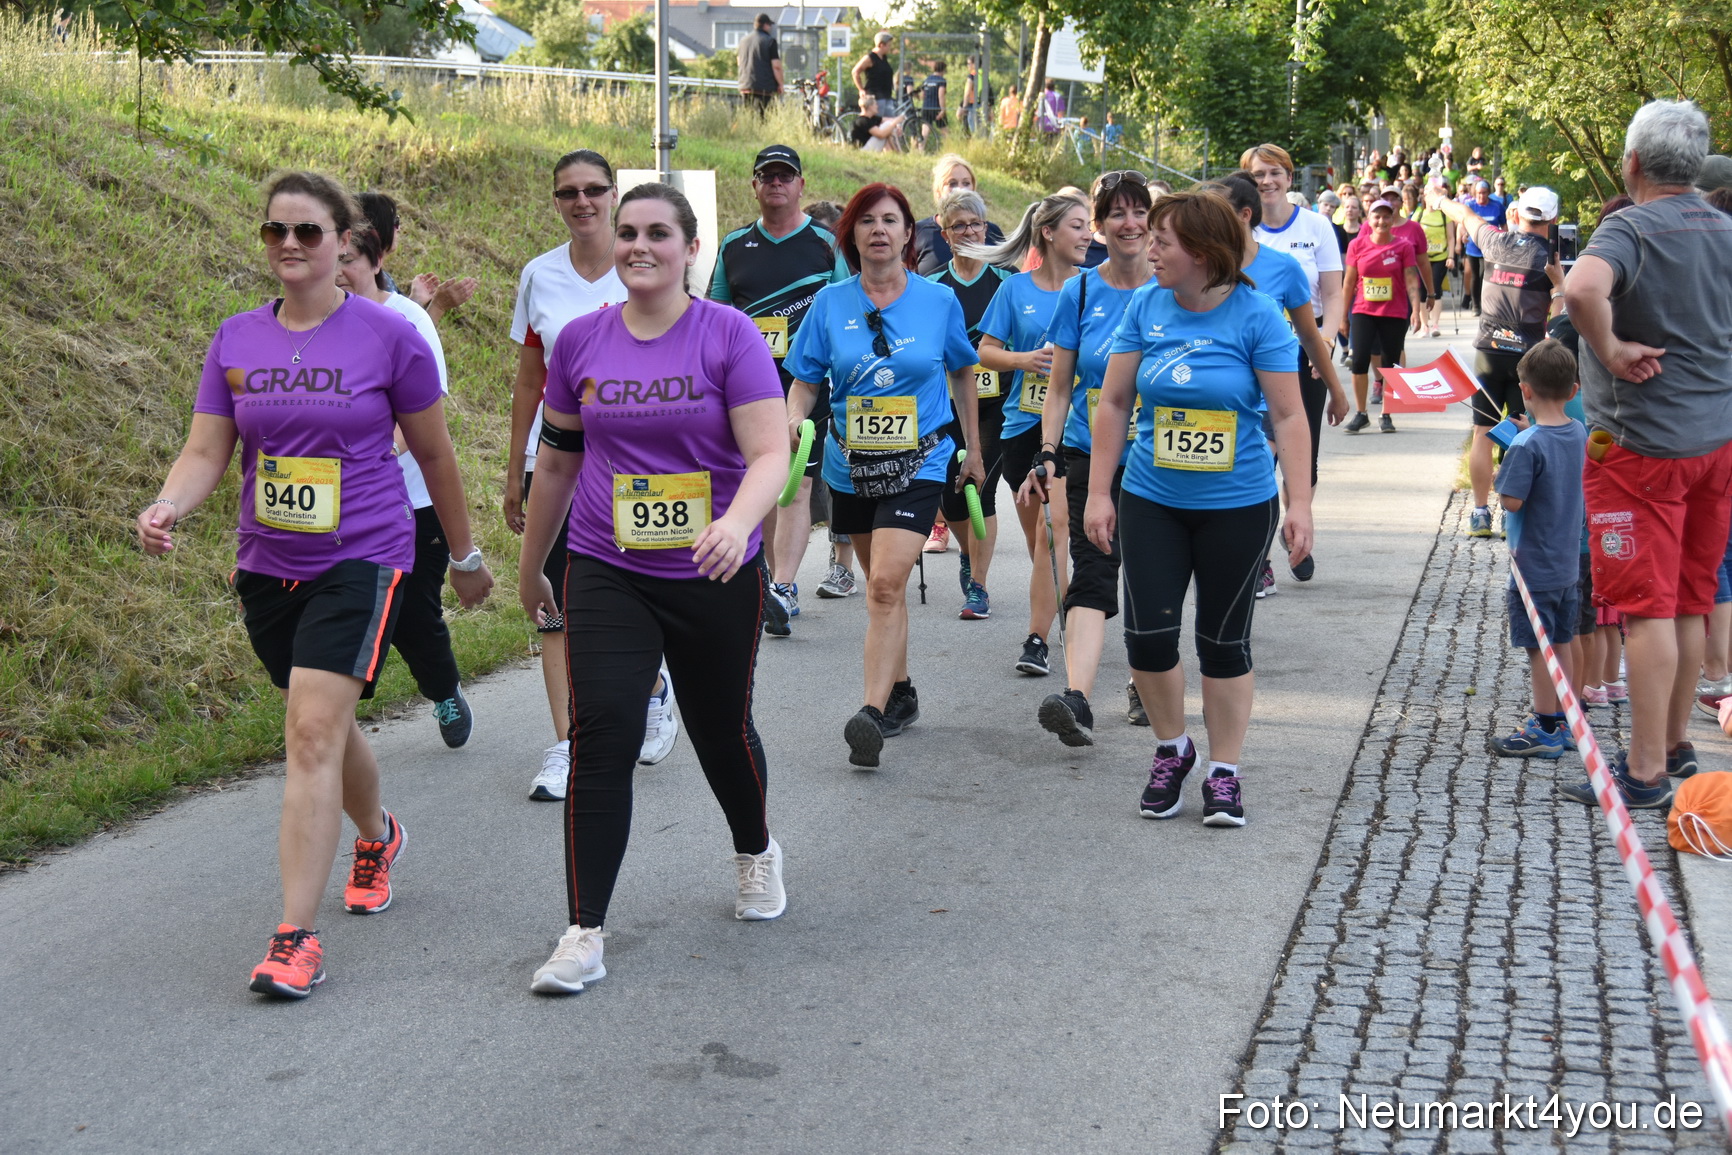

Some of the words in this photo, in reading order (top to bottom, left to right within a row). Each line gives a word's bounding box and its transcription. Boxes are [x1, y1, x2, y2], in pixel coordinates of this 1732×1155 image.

[1366, 286, 1388, 295] 2173
[1093, 337, 1113, 357] Team
[847, 363, 862, 384] Team
[894, 336, 916, 347] Bau
[1143, 358, 1164, 379] Team
[1163, 341, 1192, 360] Schick
[1193, 338, 1213, 347] Bau
[246, 368, 352, 395] GRADL
[596, 375, 704, 405] GRADL
[855, 415, 908, 435] 1527
[1164, 429, 1224, 454] 1525
[1191, 454, 1209, 462] Birgit
[264, 482, 316, 512] 940
[625, 488, 665, 497] firmenlauf
[265, 507, 282, 516] Gradl
[283, 510, 317, 520] Christina
[632, 501, 689, 528] 938
[670, 527, 694, 535] Nicole
